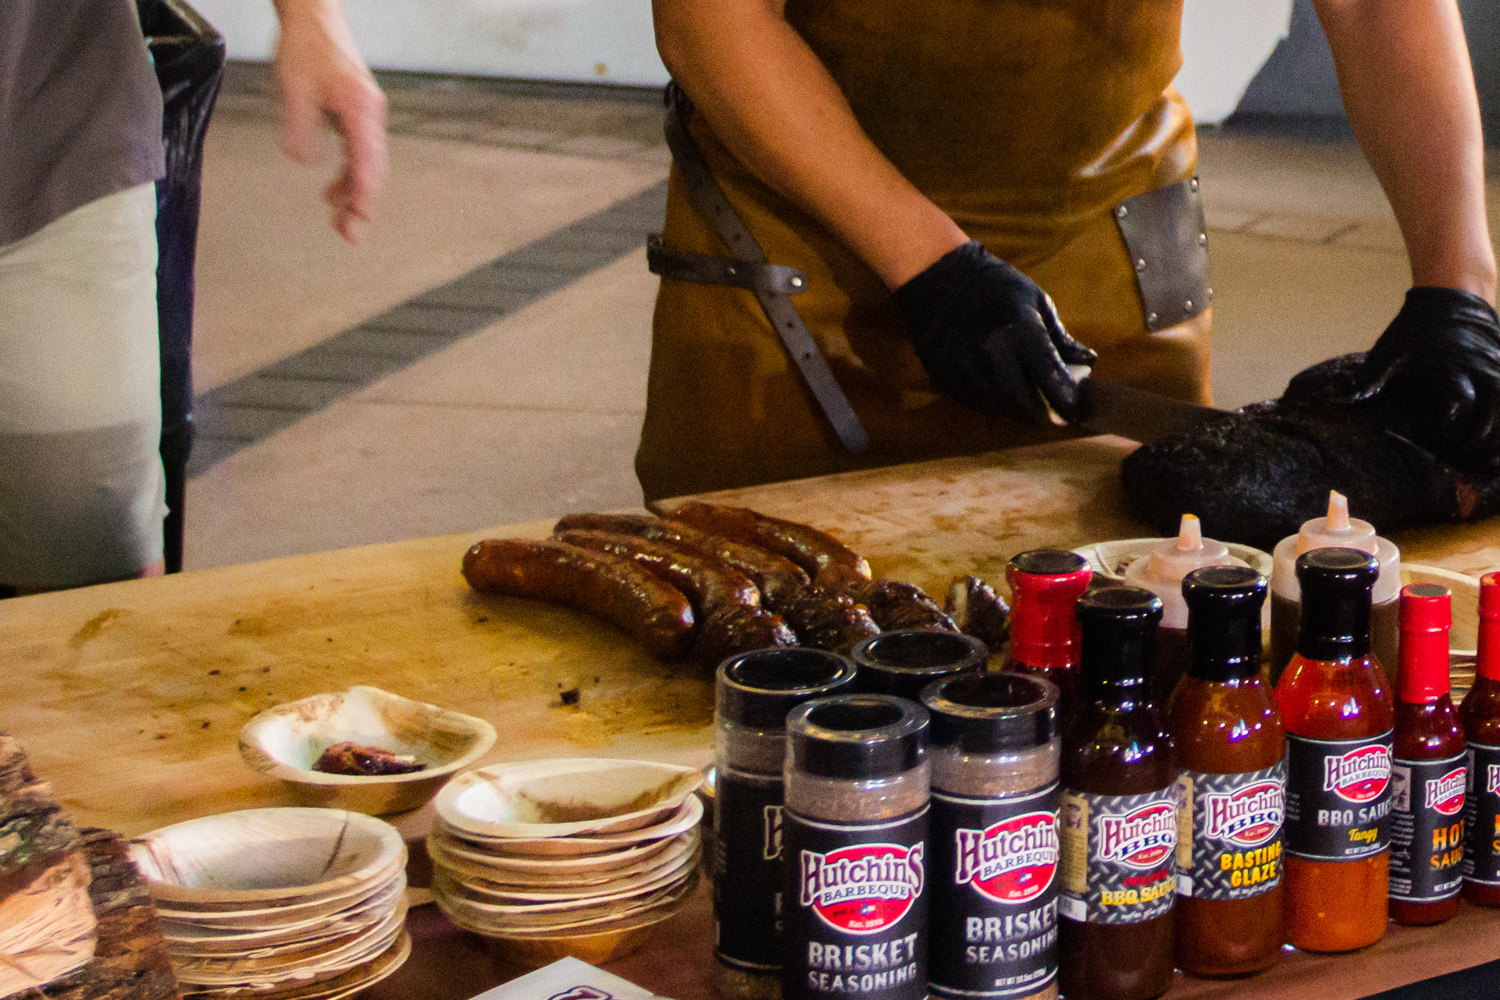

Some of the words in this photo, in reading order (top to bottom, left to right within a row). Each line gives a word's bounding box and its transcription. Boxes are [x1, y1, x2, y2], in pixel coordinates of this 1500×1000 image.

[1227, 811, 1279, 835] BBQ
[1348, 827, 1378, 843] Tangy
[1121, 832, 1173, 858] BBQ
[1230, 861, 1277, 888] GLAZE
[823, 883, 909, 902] BARBEQUE
[1100, 888, 1139, 906] BBQ
[808, 932, 918, 971] BRISKET
[808, 962, 918, 992] SEASONING
